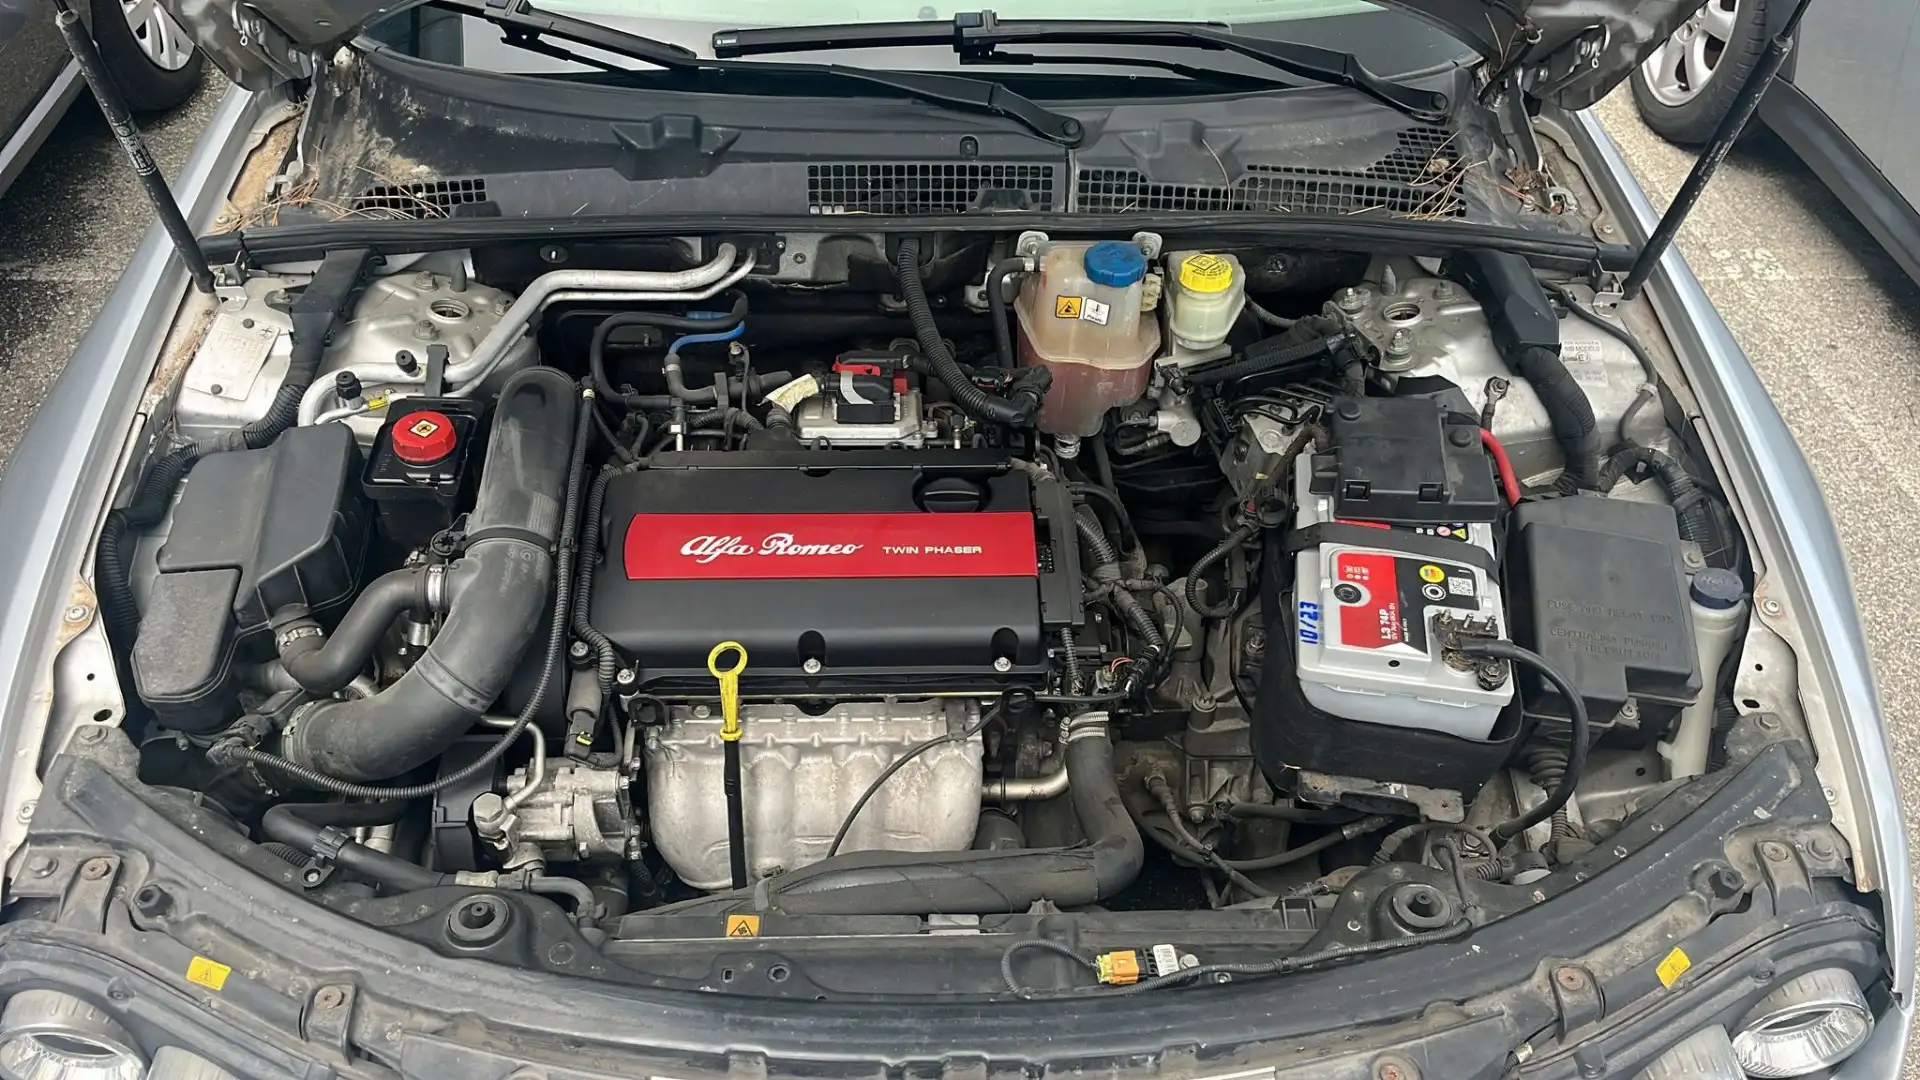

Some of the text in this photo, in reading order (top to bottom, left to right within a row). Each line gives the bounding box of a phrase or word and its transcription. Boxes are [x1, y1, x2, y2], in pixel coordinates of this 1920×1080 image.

[680, 532, 865, 564] Alfa Romeo
[882, 546, 982, 555] TWIN PHASER
[1547, 599, 1575, 613] FUSE
[1608, 608, 1643, 620] RELAY
[1299, 601, 1319, 645] 10/23
[1381, 626, 1392, 640] L3
[1550, 627, 1617, 642] CENTRALINA
